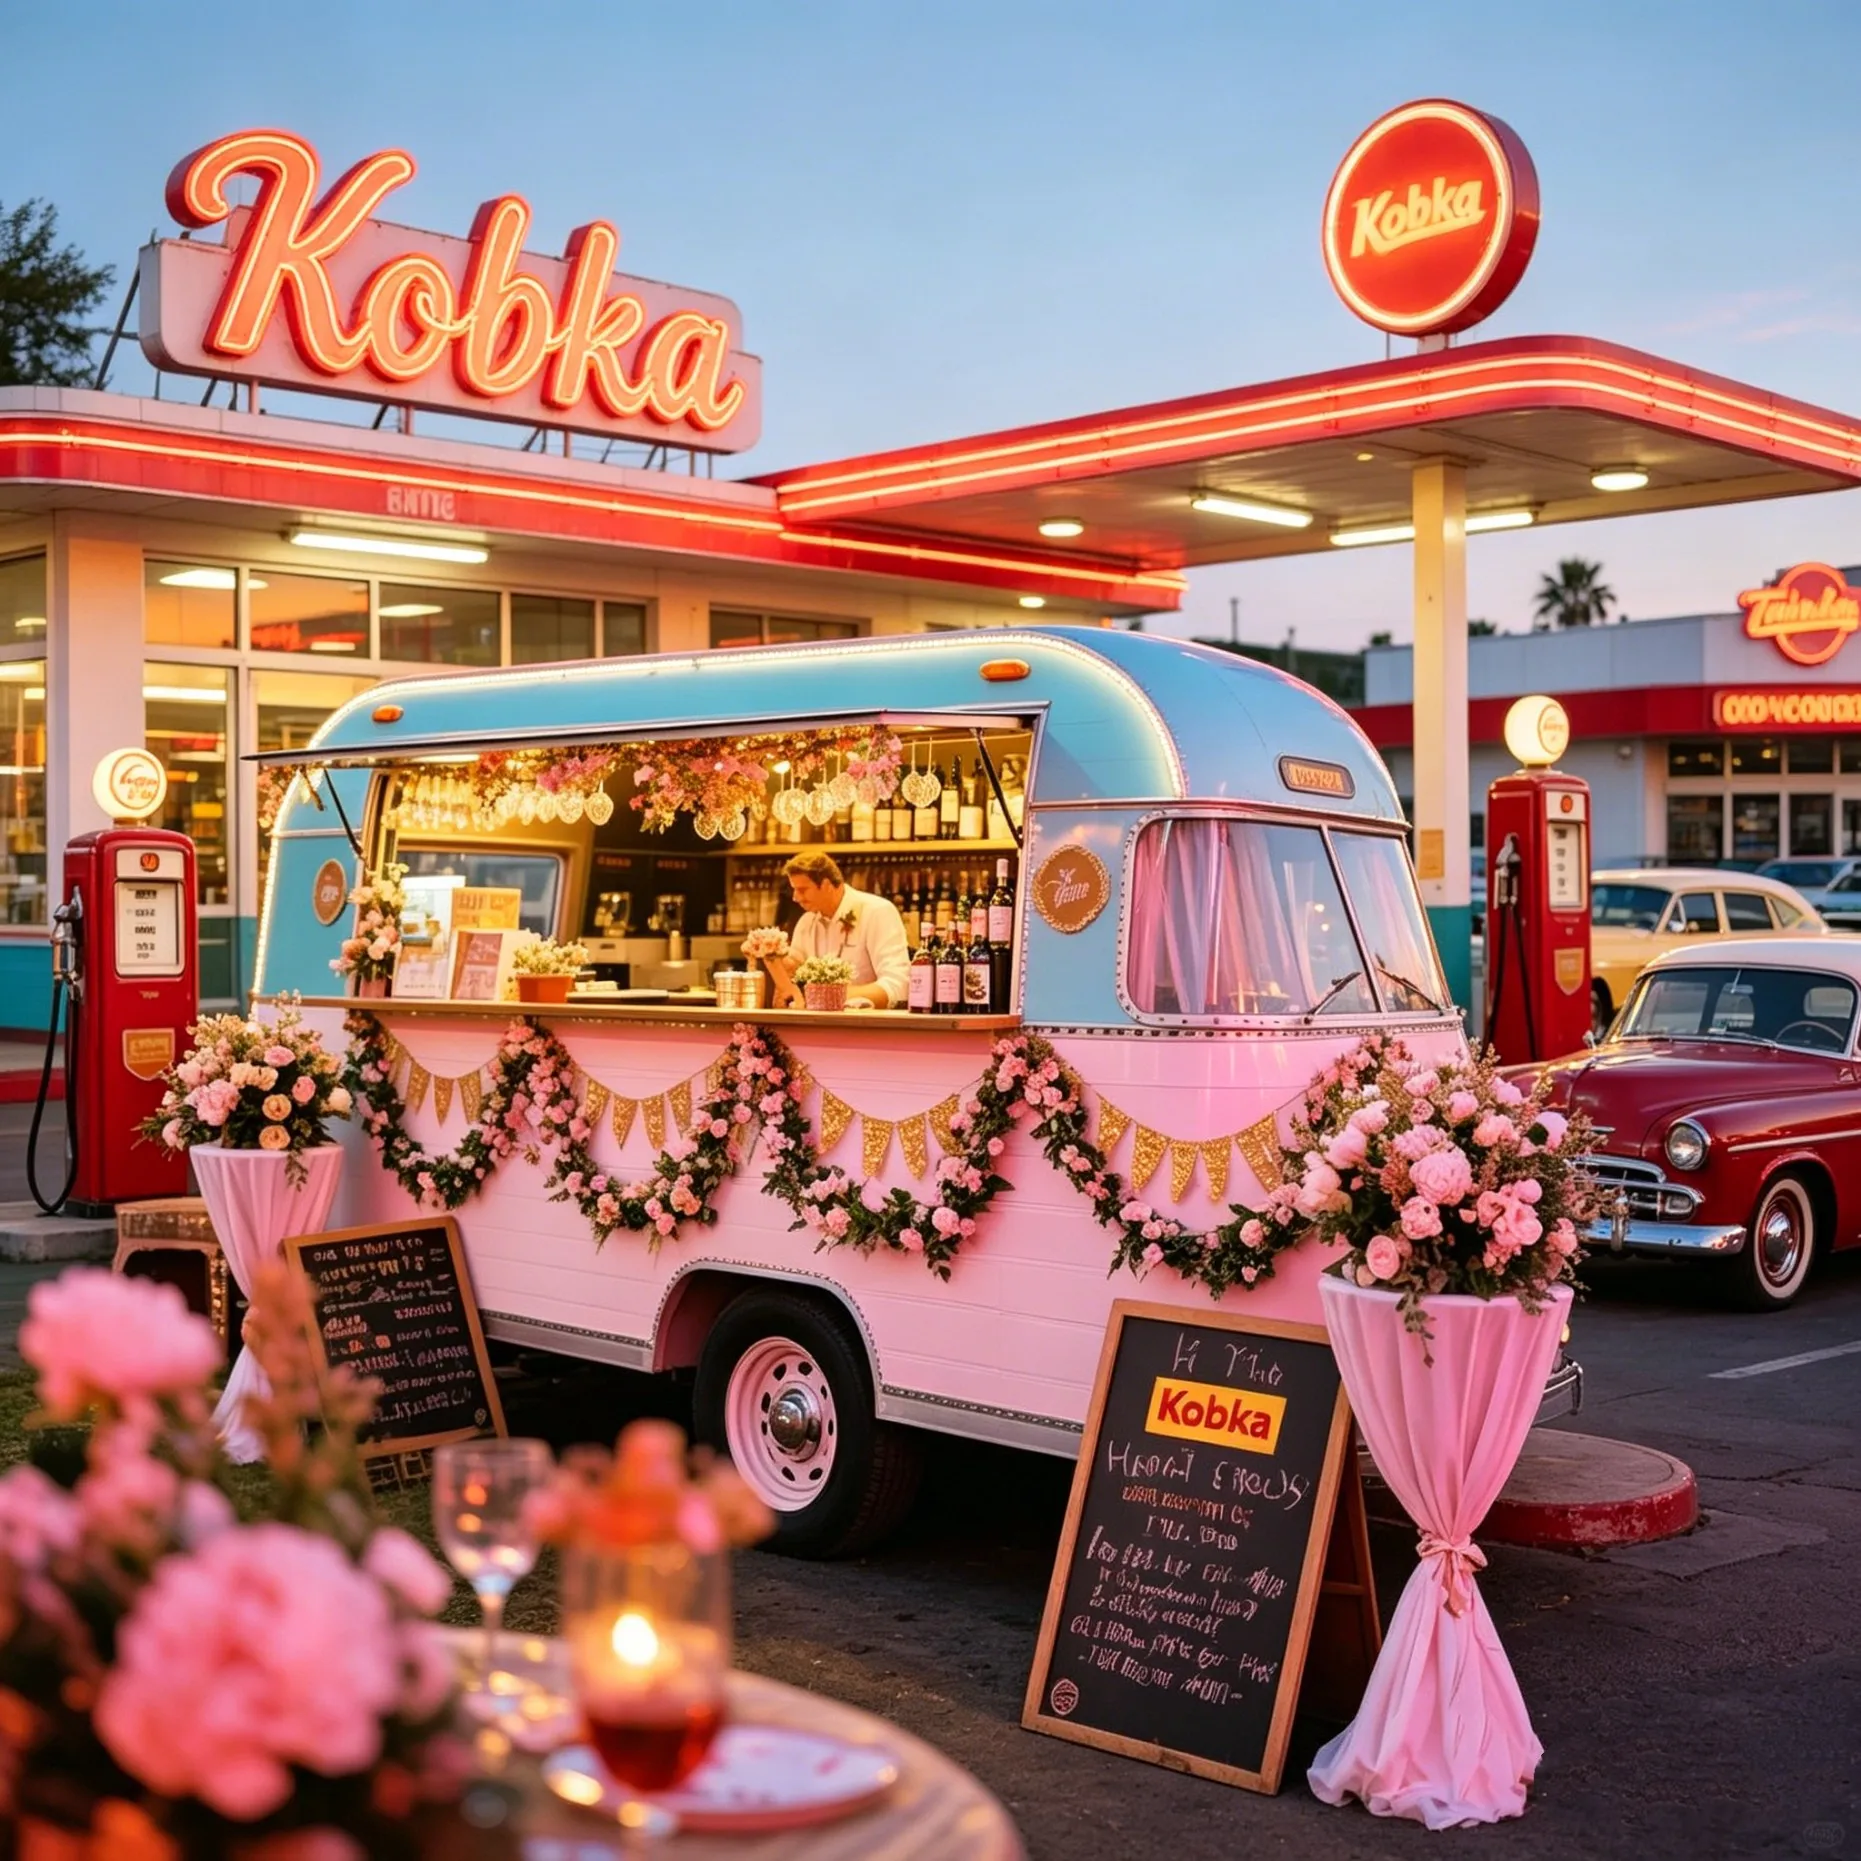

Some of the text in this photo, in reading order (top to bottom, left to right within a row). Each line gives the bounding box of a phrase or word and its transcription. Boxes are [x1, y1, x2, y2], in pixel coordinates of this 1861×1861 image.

[1350, 176, 1487, 258] Kobka
[166, 128, 747, 430] Kobka
[1157, 1388, 1272, 1440] Kobka
